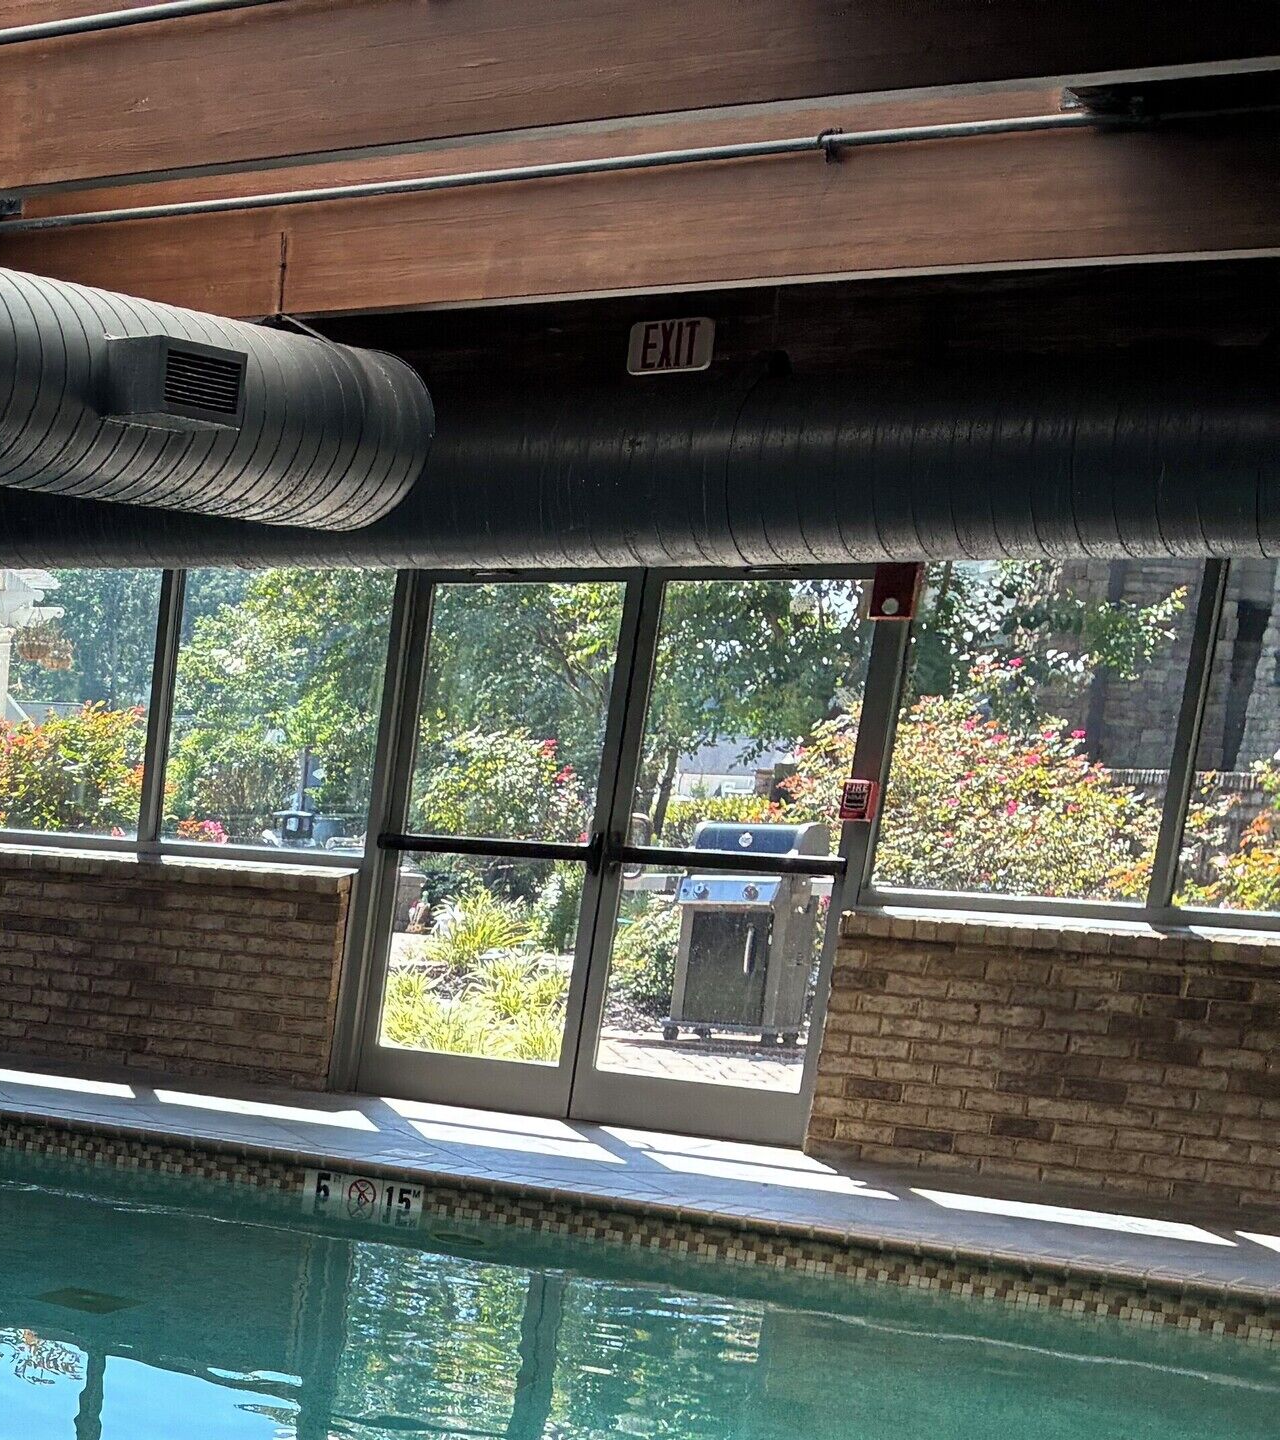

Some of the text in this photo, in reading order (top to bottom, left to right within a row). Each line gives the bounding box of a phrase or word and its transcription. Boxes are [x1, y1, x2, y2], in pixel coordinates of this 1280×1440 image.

[640, 320, 701, 369] EXIT
[846, 784, 869, 793] FIRE
[386, 1186, 411, 1210] 15
